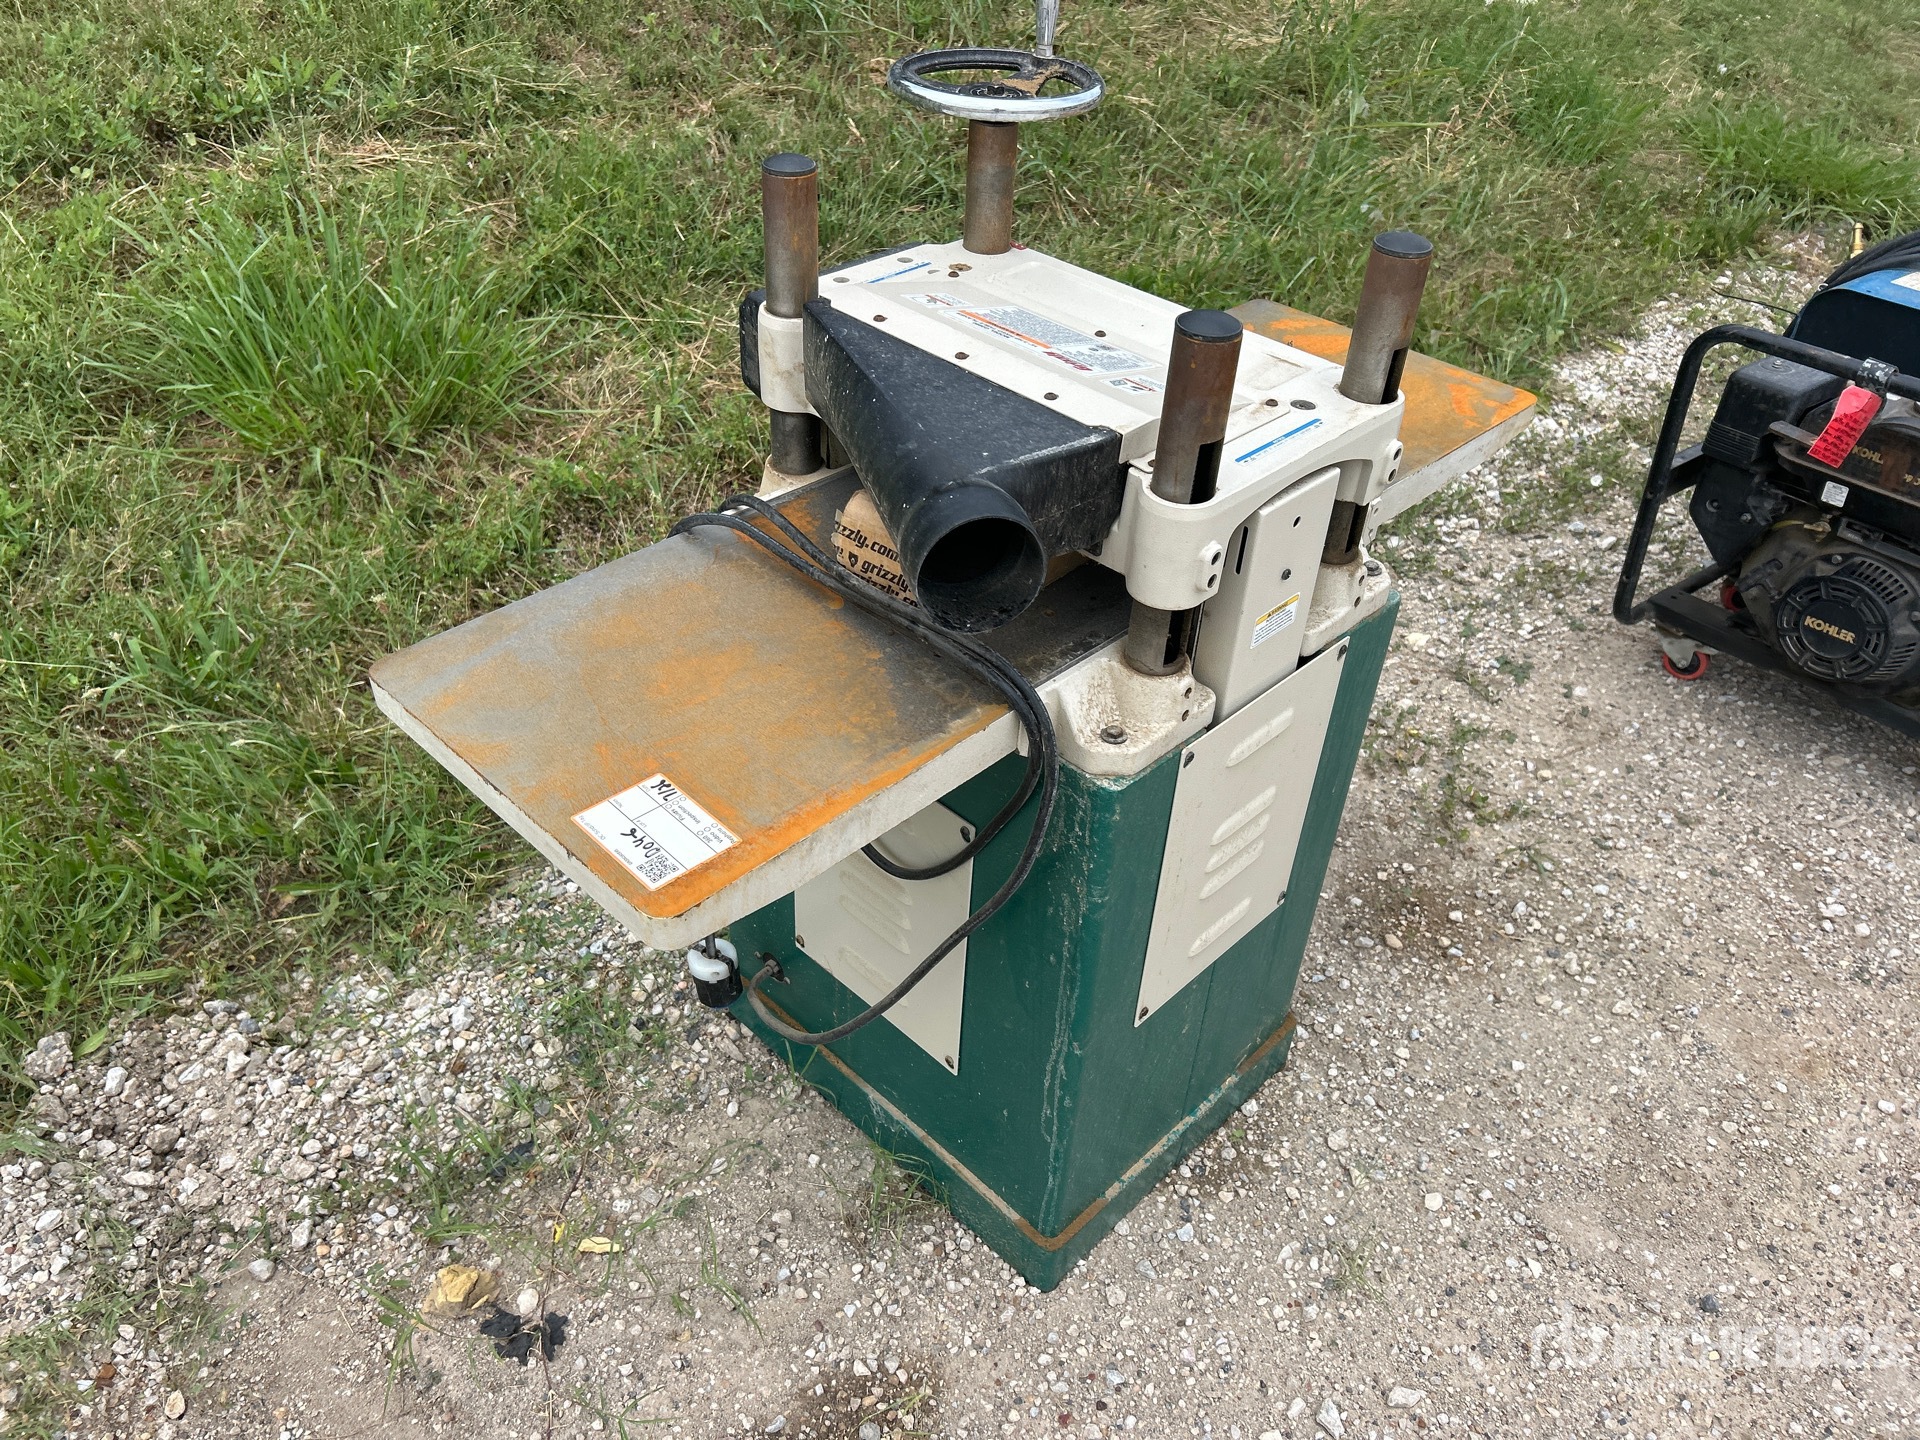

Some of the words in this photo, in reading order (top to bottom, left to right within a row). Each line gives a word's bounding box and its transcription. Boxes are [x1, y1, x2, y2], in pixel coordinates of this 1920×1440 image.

[1851, 446, 1884, 464] KOHL
[1804, 615, 1856, 644] KOHLER
[678, 804, 701, 824] Inspection
[709, 831, 723, 844] Video
